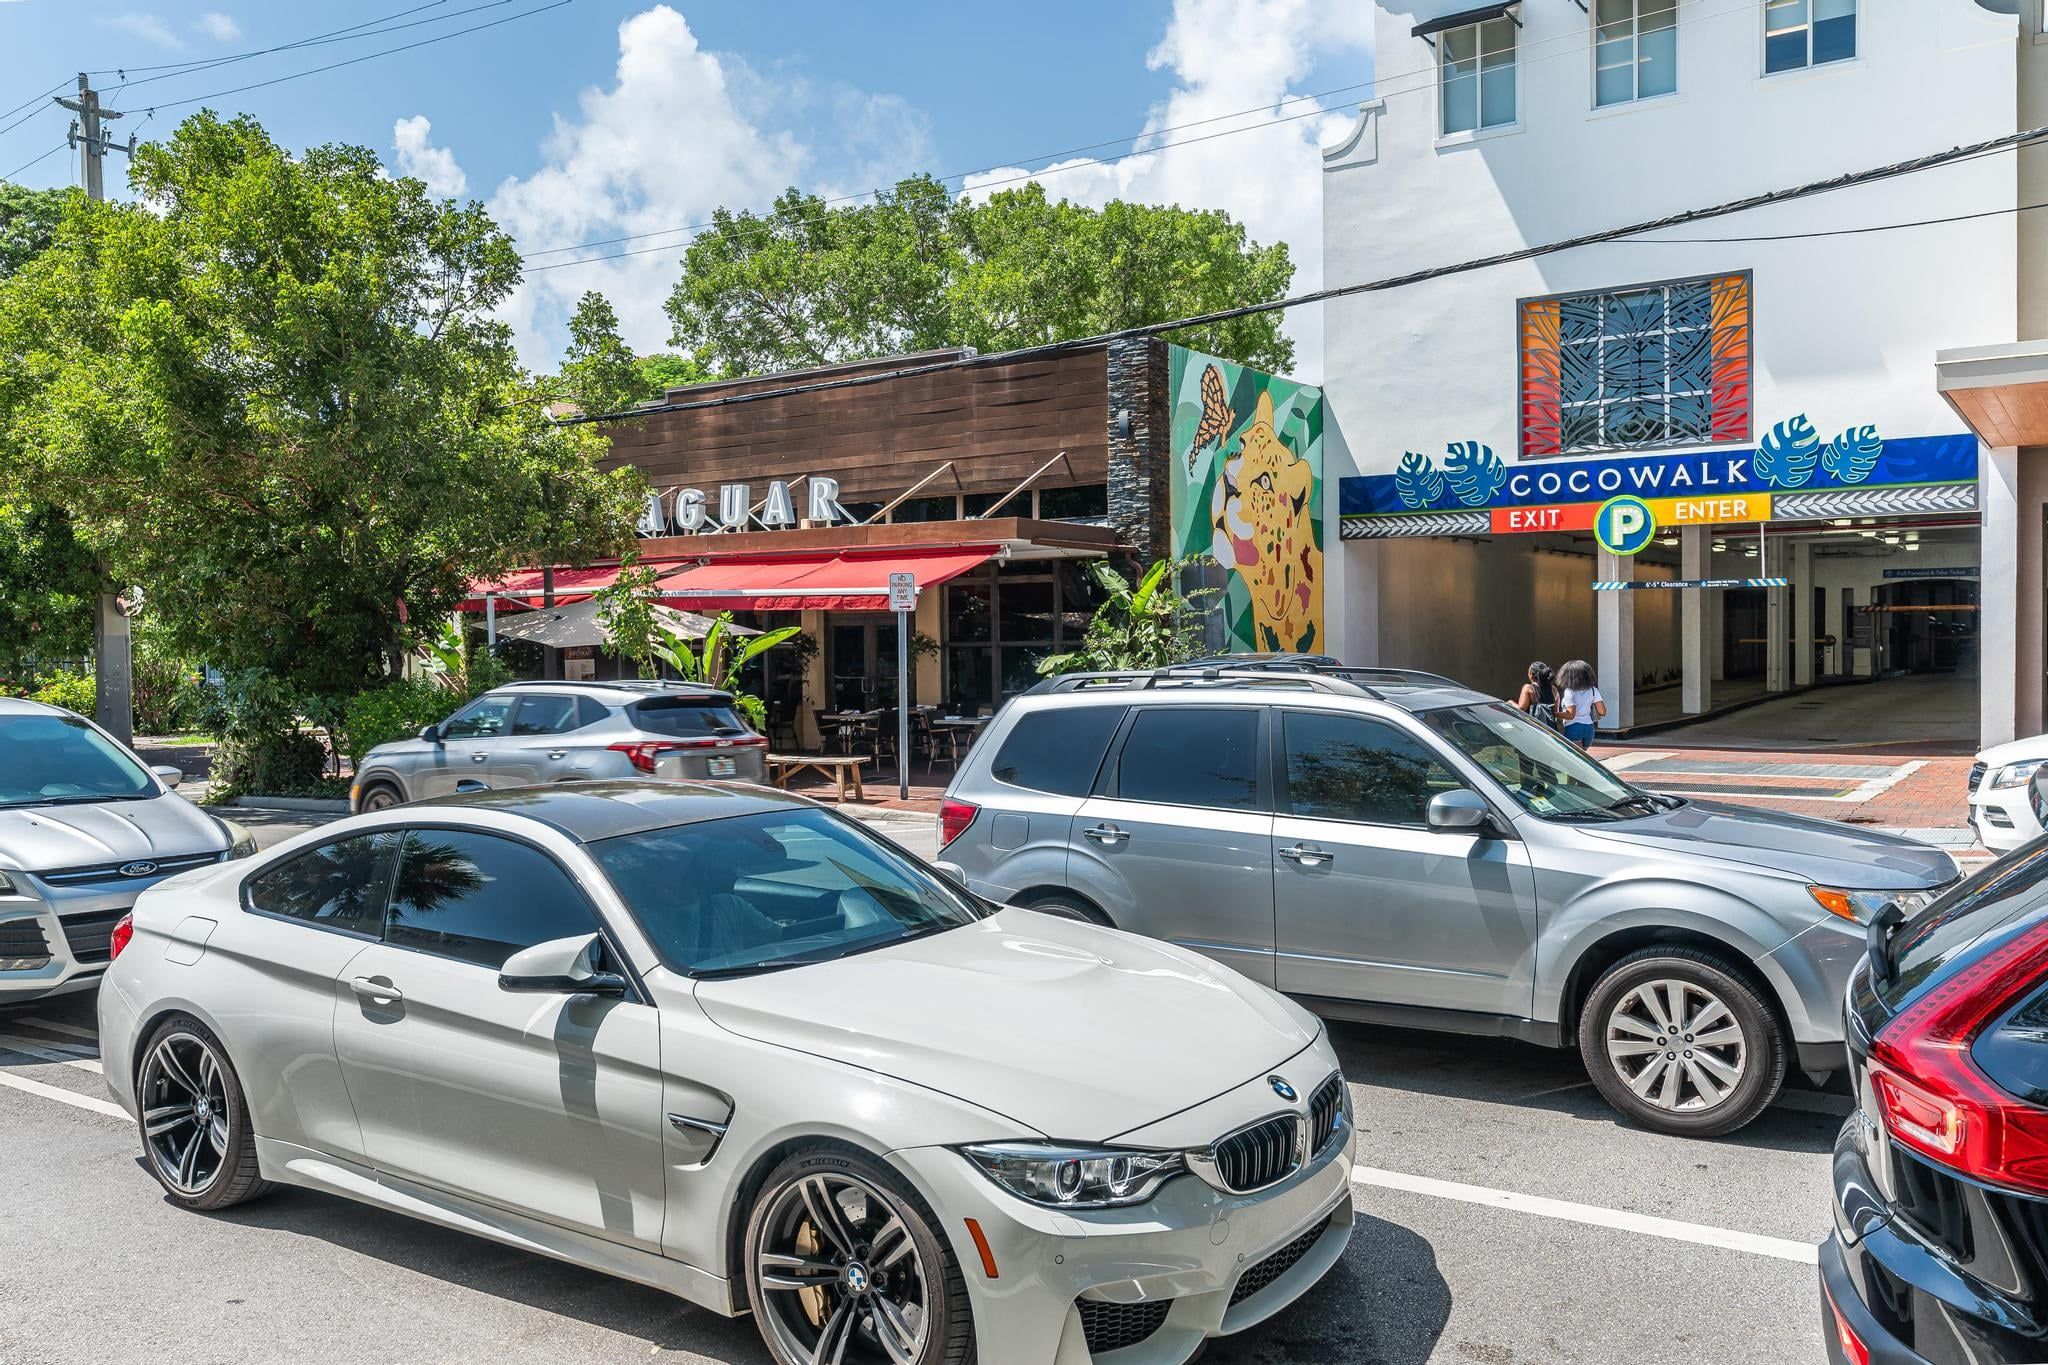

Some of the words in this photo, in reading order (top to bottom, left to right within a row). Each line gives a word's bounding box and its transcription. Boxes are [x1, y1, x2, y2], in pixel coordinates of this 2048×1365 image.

[1510, 459, 1747, 497] COCOWALK
[638, 477, 841, 532] AGUAR
[1510, 509, 1560, 528] EXIT
[1675, 499, 1747, 520] ENTER
[1610, 504, 1645, 546] P
[130, 864, 150, 873] Ford
